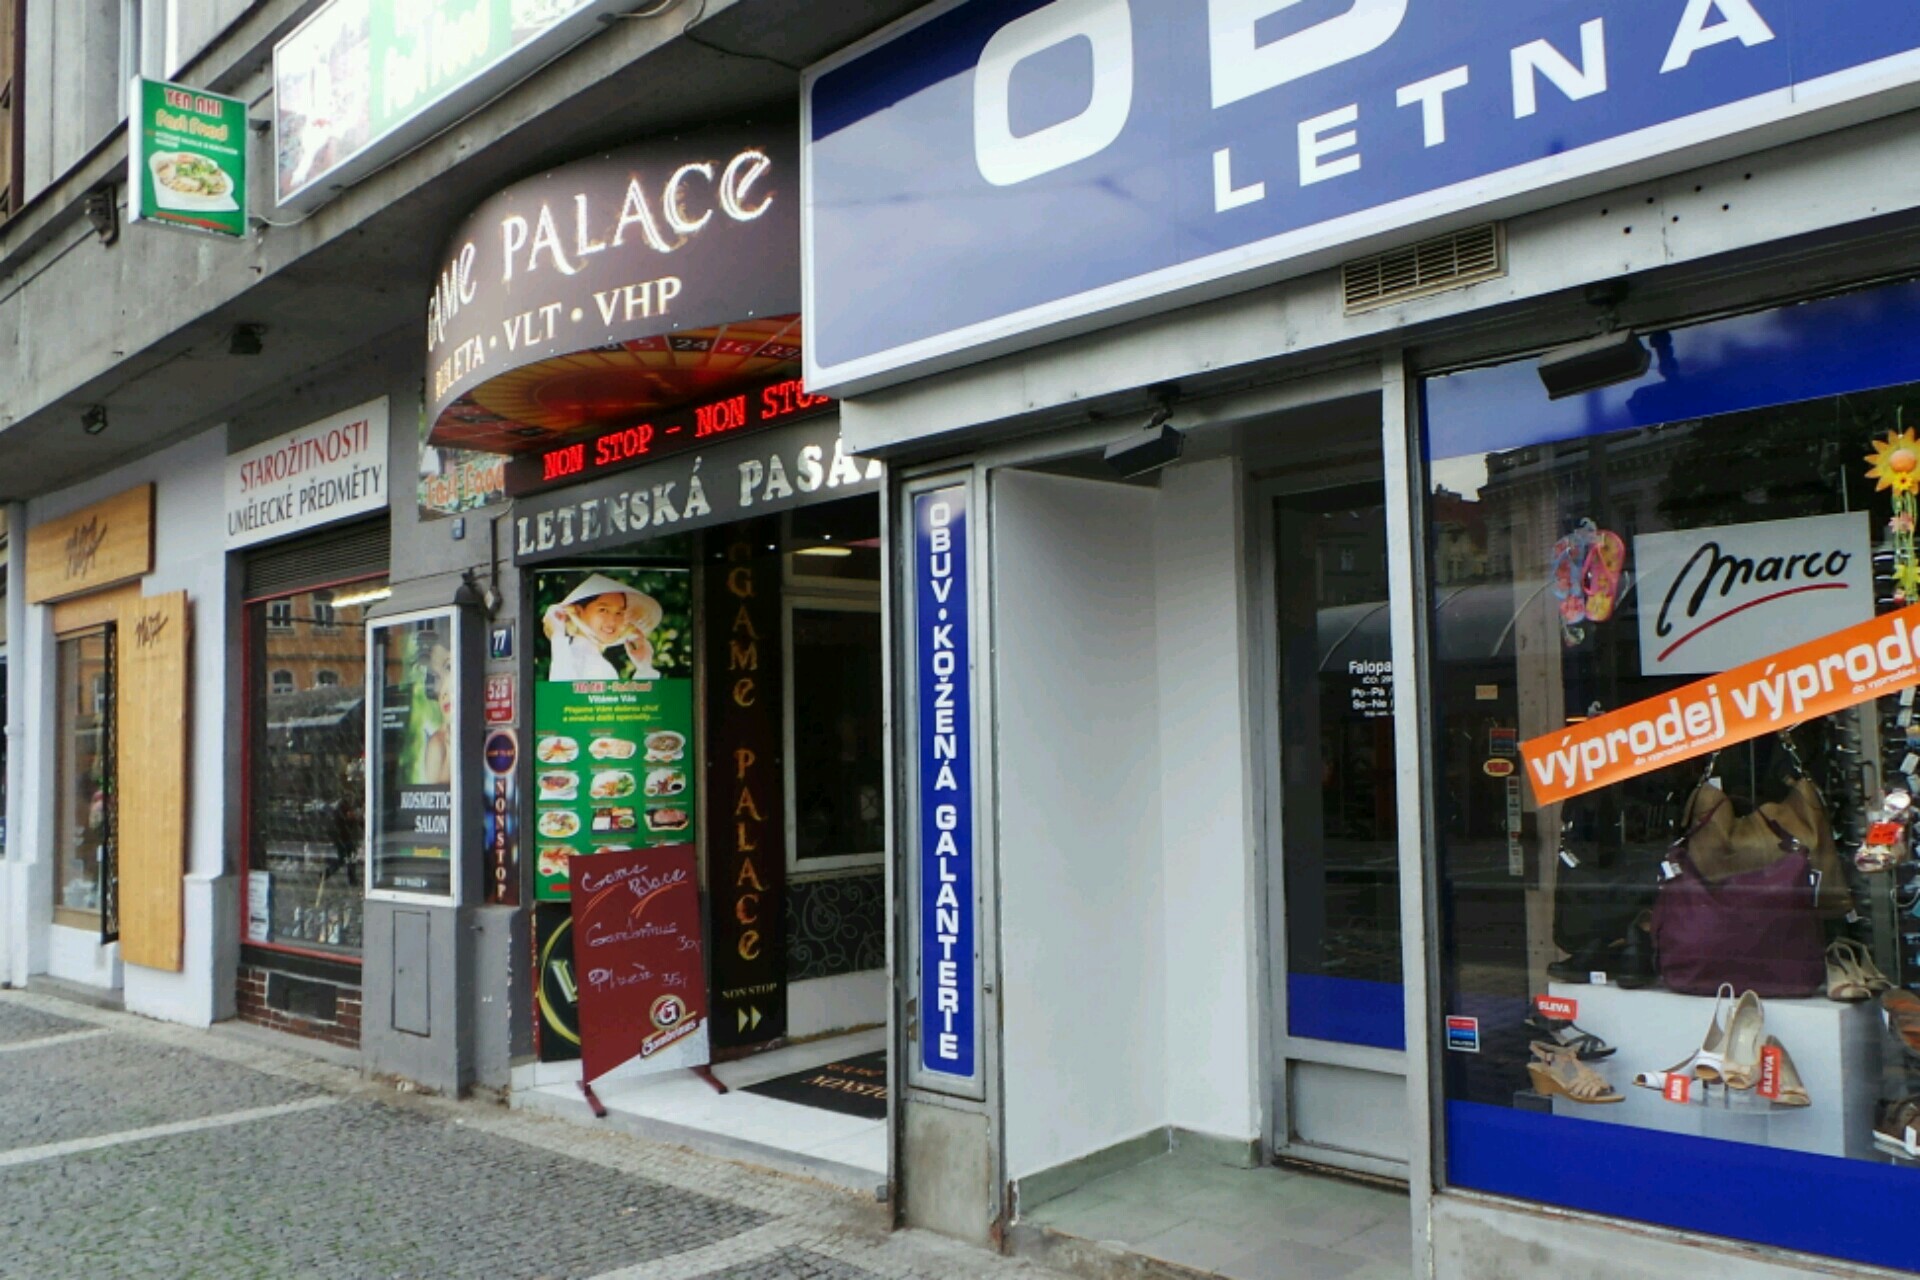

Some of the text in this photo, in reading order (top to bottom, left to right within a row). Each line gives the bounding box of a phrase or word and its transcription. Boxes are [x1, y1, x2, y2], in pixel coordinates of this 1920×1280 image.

[503, 302, 562, 351] VLT
[593, 276, 682, 327] VHP
[239, 419, 369, 493] STAROŽITNOSTI
[543, 444, 584, 481] NON
[594, 424, 655, 466] STOP
[695, 394, 747, 438] NON
[762, 378, 831, 420] STO
[228, 462, 383, 536] UMĚLECKÉ PŘEDMĚTY
[516, 456, 712, 556] LETENSKÁ
[493, 629, 507, 651] 77
[1532, 684, 1726, 788] výprodej
[930, 502, 959, 1060] OBUV KOŽENÁ GALANTERIE
[415, 814, 449, 834] SALON
[1538, 1000, 1571, 1014] SLEVA
[1763, 1054, 1775, 1094] SLEVA
